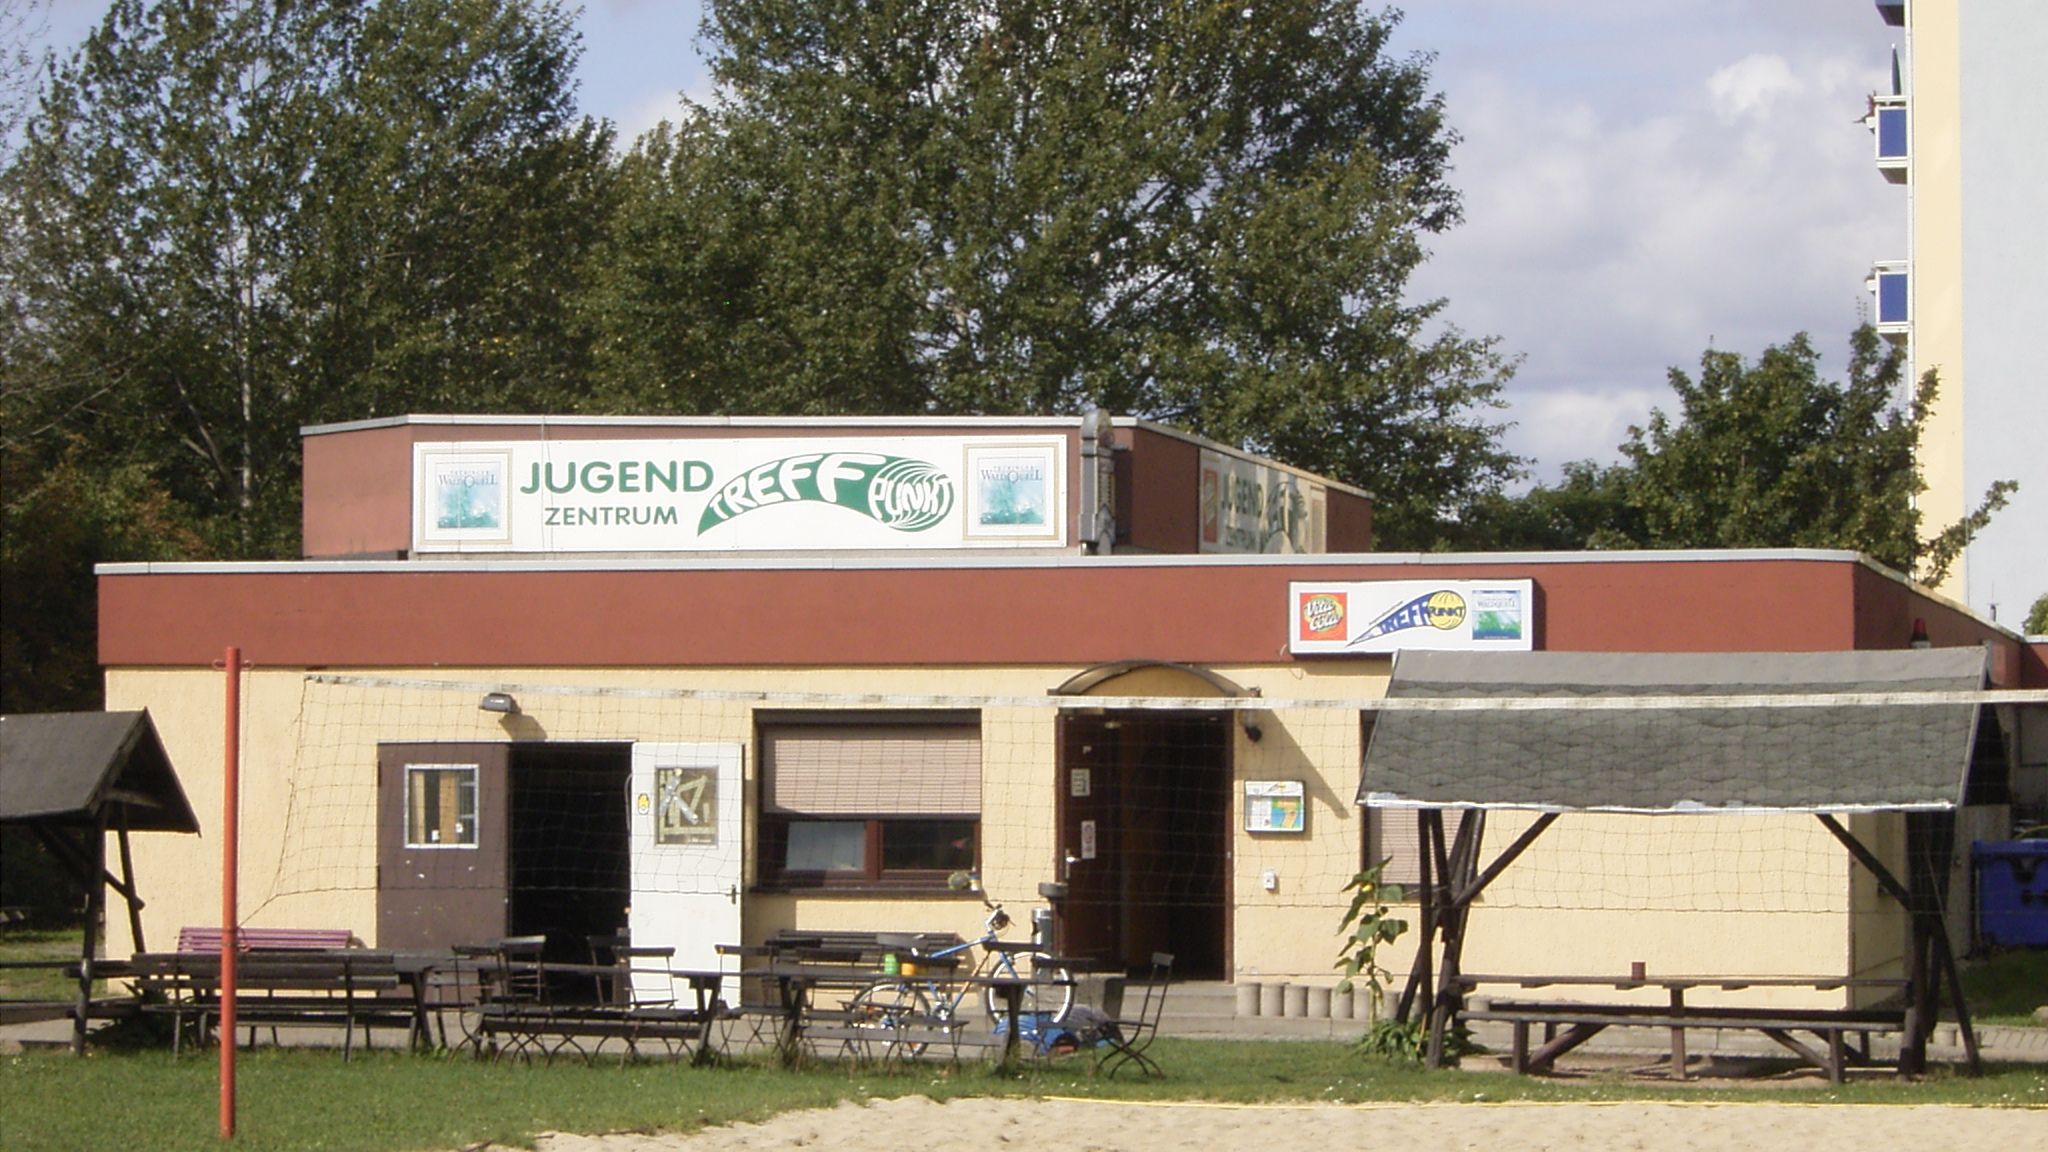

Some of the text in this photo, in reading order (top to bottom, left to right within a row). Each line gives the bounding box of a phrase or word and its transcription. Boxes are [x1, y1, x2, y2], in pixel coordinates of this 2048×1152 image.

[520, 459, 714, 494] JUGEND
[709, 453, 886, 520] TREFF
[872, 473, 953, 520] PUNKT
[544, 505, 678, 526] ZENTRUM
